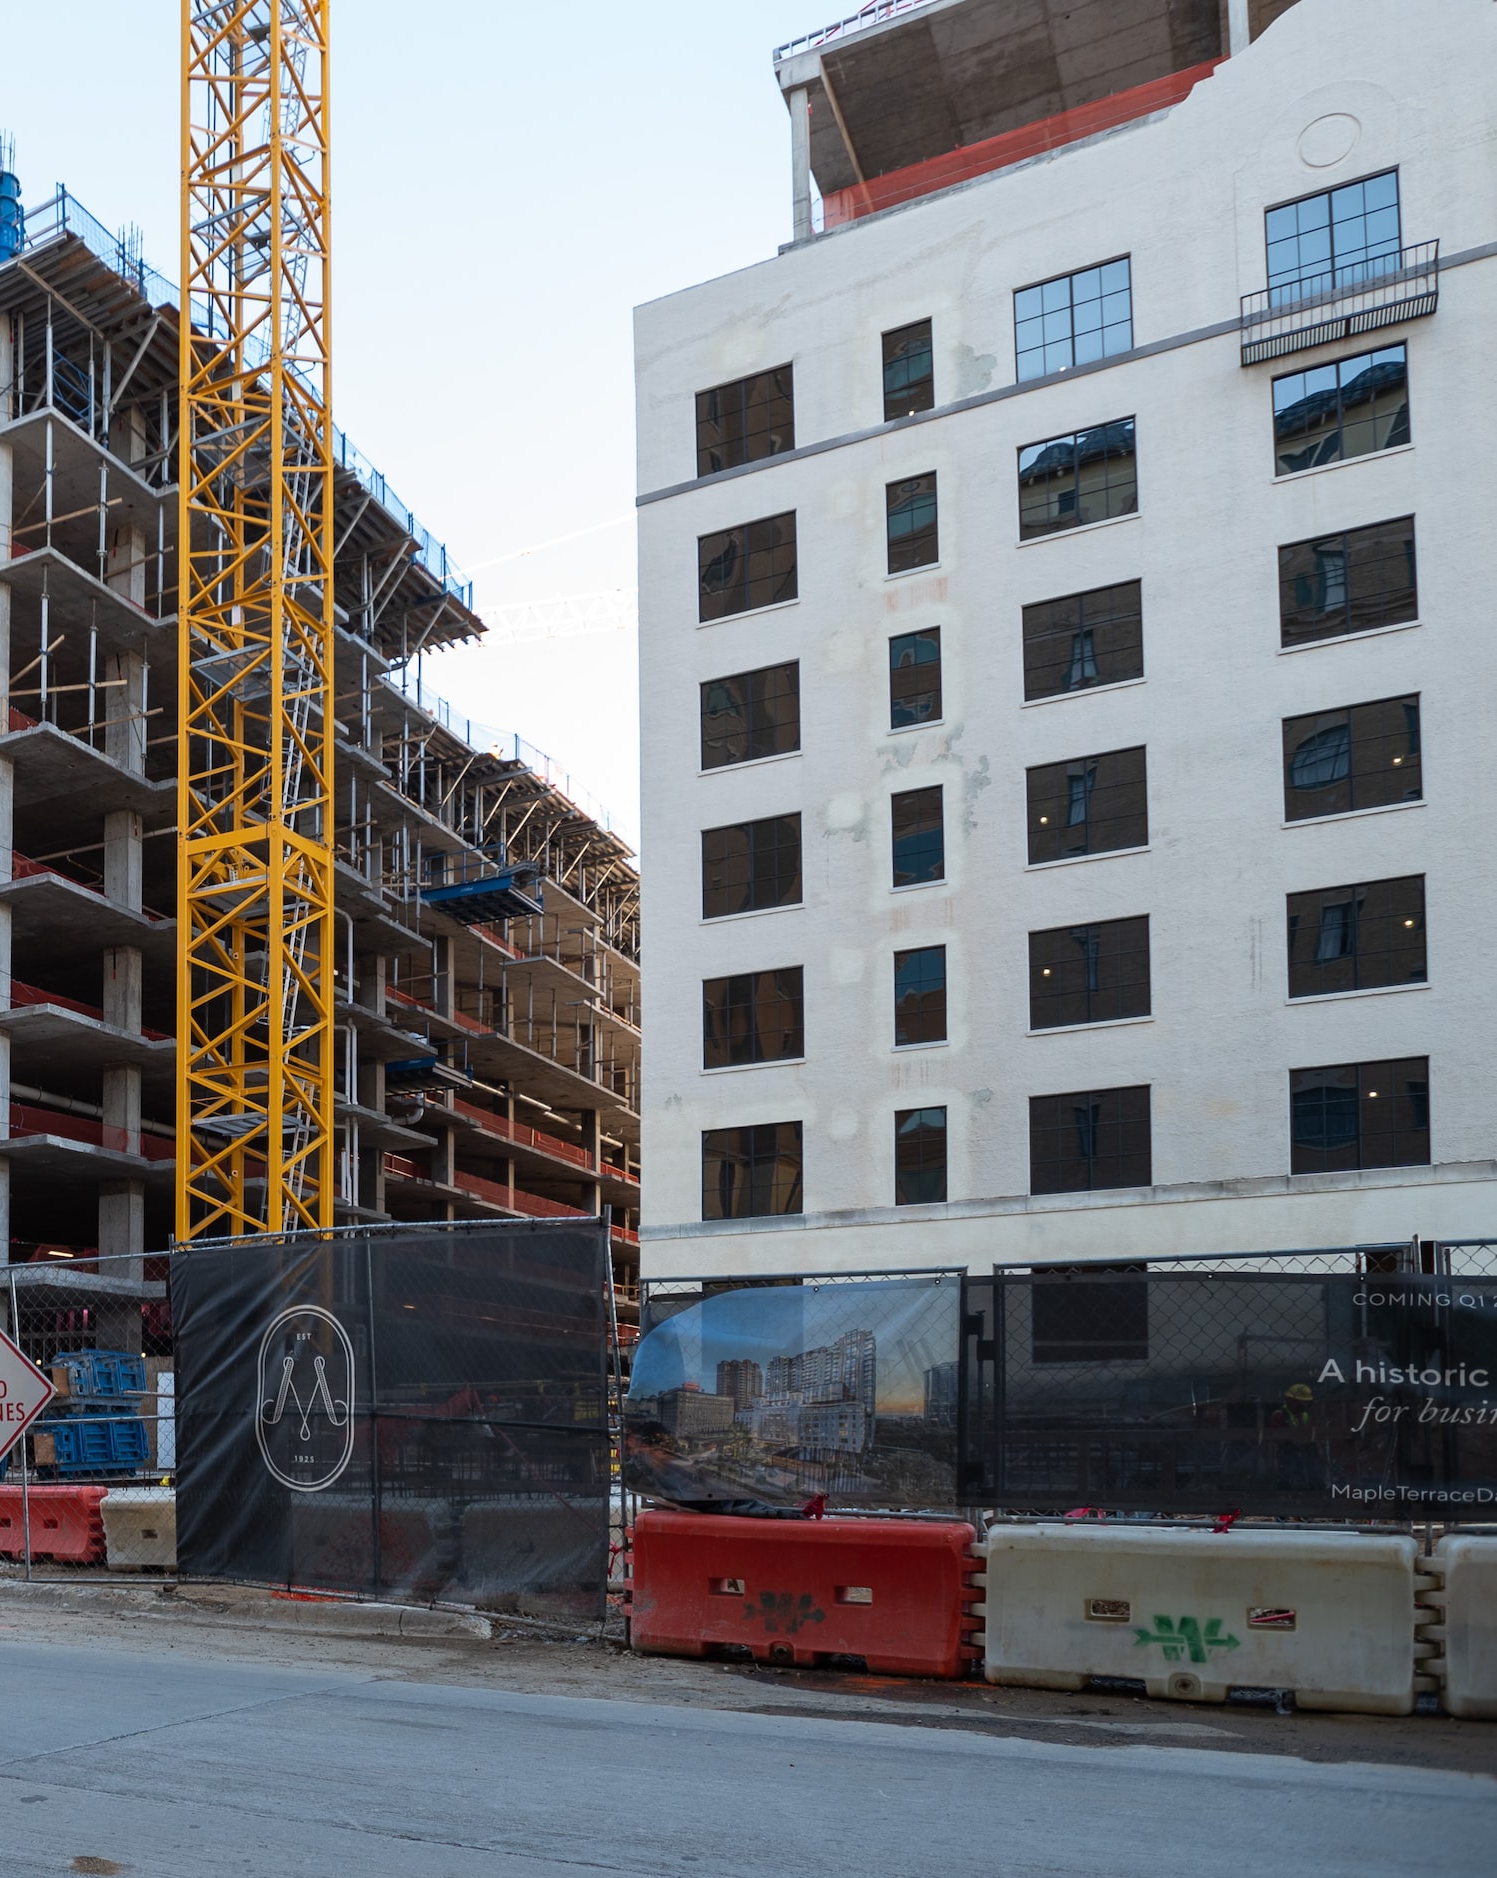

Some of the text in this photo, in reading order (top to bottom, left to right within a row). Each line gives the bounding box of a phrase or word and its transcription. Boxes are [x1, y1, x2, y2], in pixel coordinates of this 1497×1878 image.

[1352, 1293, 1451, 1307] COMING
[1459, 1294, 1484, 1309] Q1
[295, 1332, 312, 1341] EST
[1317, 1358, 1490, 1387] A historic
[1350, 1396, 1410, 1432] for
[294, 1455, 315, 1463] 1925
[1331, 1484, 1497, 1503] MapleTerraceD
